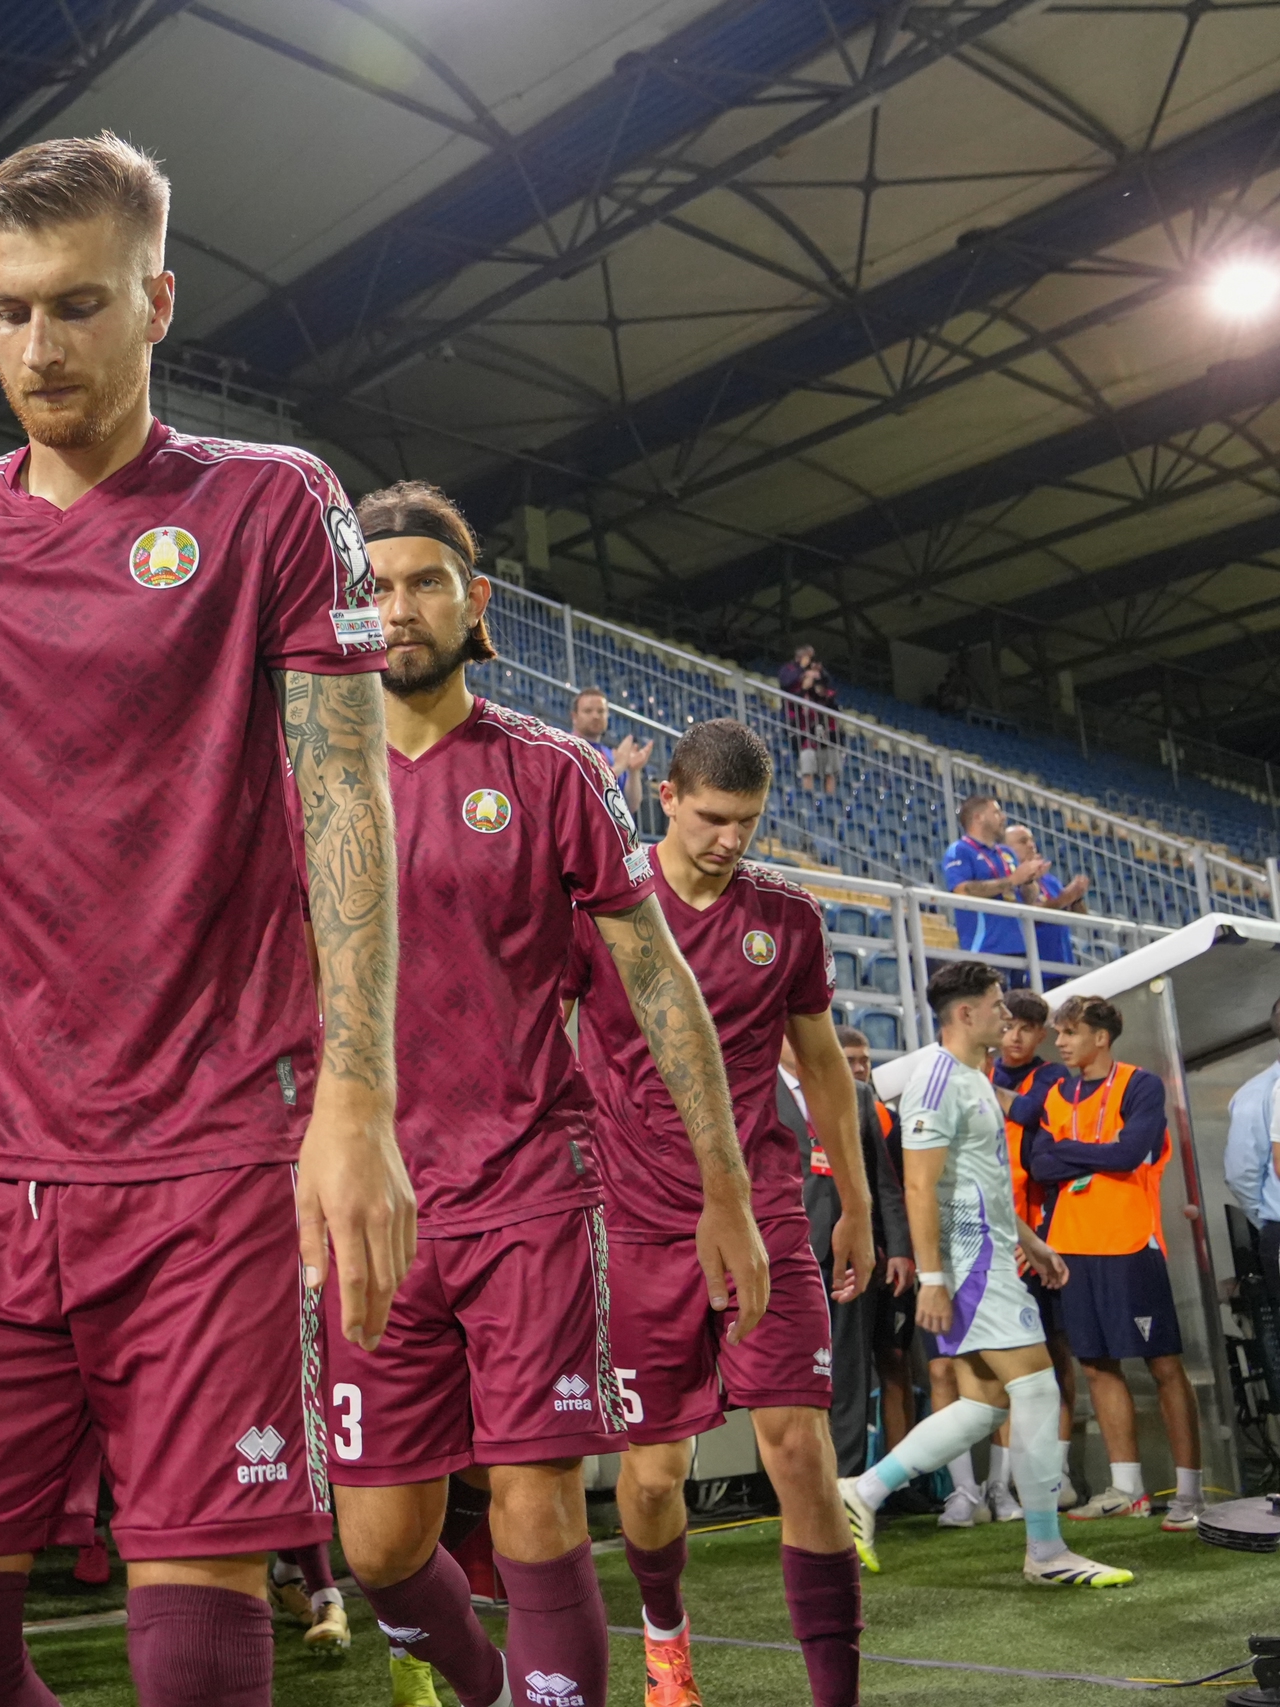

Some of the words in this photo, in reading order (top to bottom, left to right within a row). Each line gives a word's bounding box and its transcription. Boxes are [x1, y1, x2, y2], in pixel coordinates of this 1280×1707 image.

[335, 620, 380, 631] FOUNDATIO
[554, 1398, 592, 1412] errea
[333, 1382, 363, 1461] 3
[237, 1461, 288, 1484] errea
[526, 1689, 585, 1707] errea
